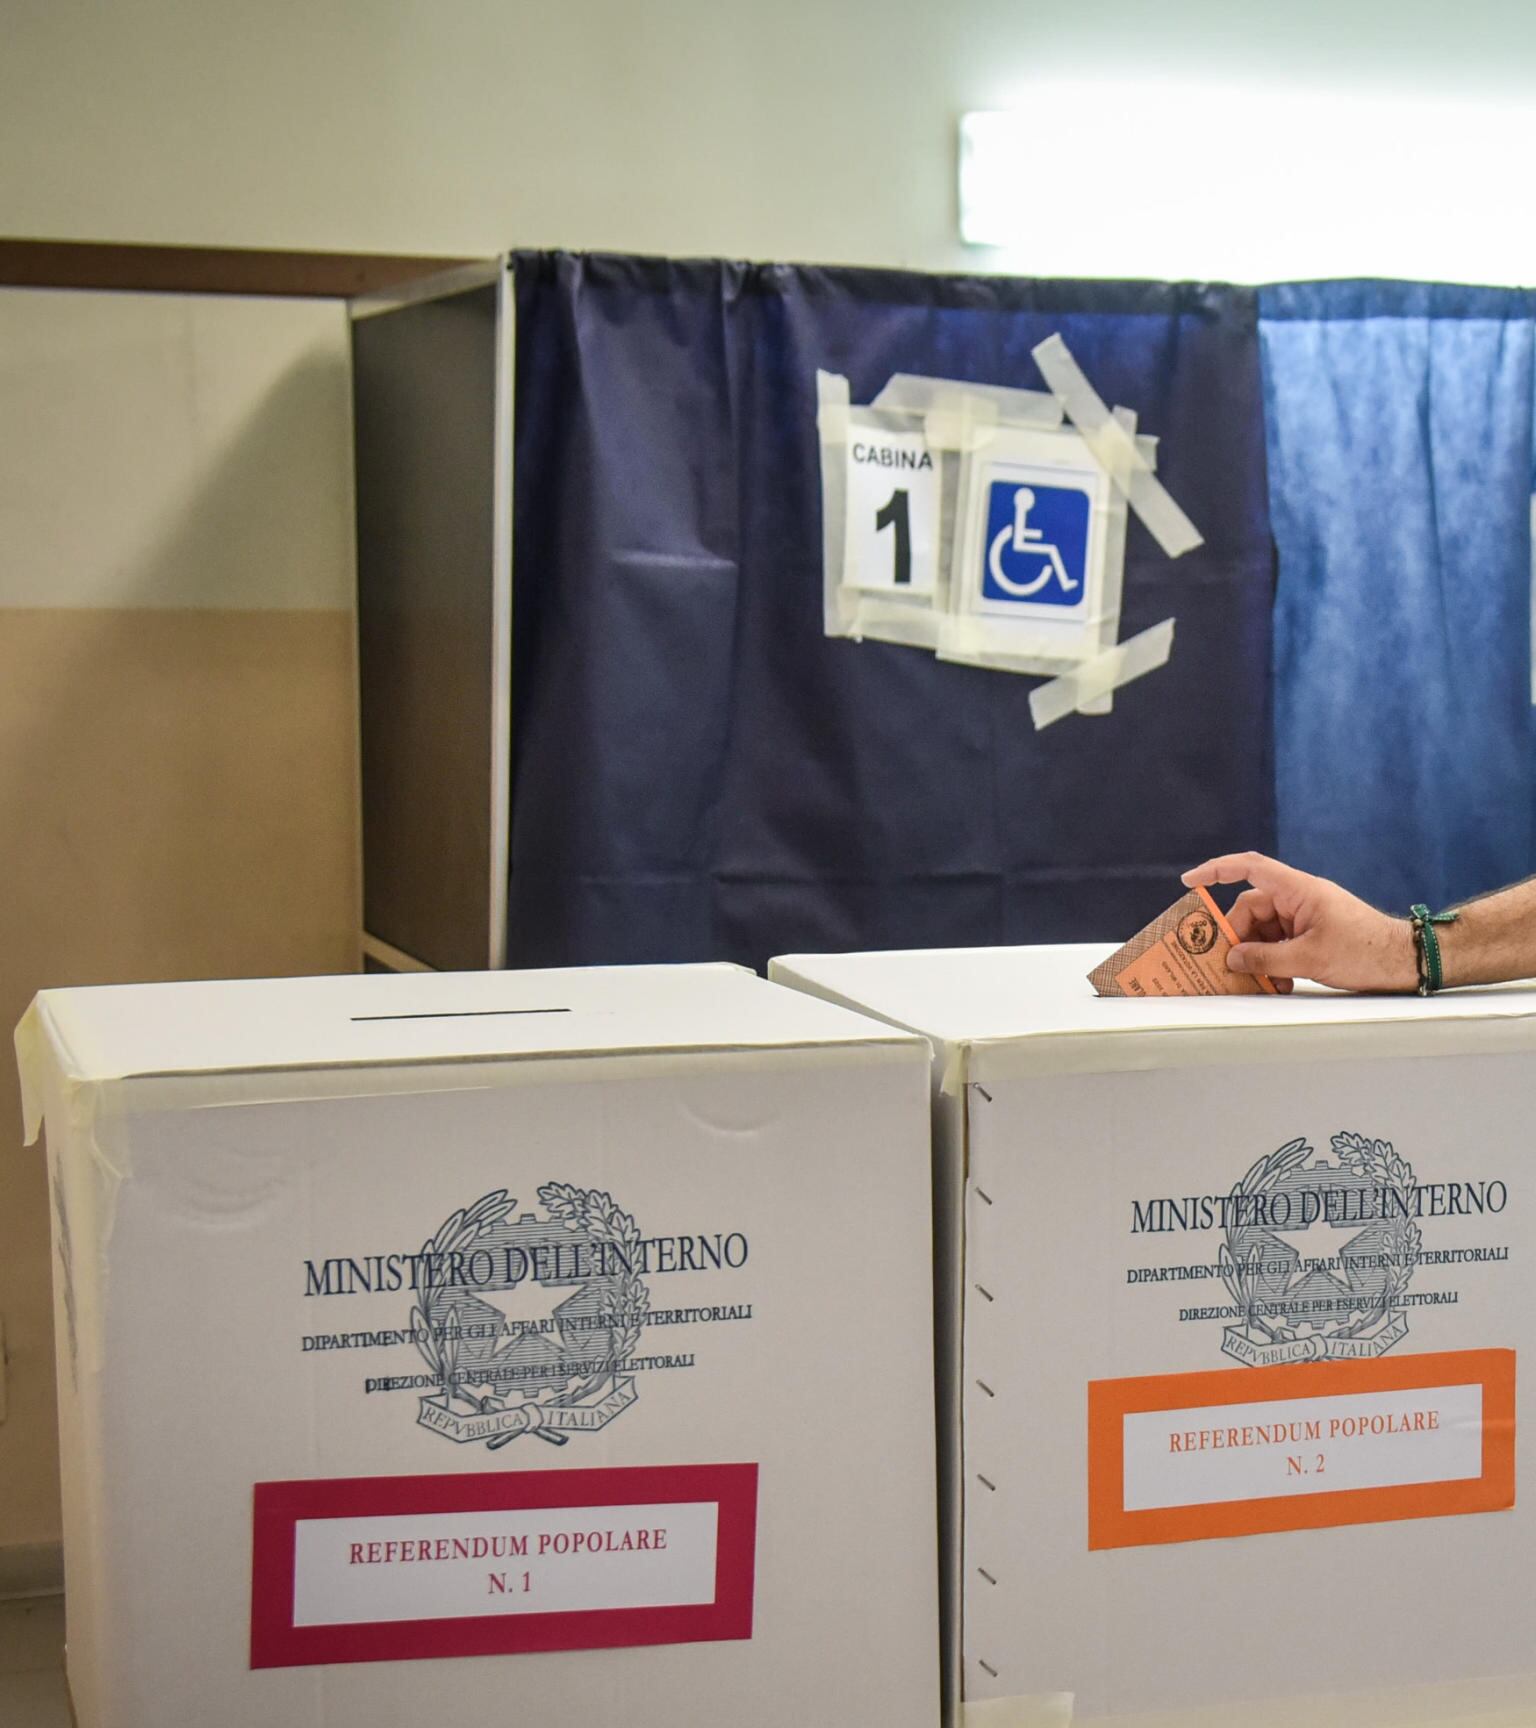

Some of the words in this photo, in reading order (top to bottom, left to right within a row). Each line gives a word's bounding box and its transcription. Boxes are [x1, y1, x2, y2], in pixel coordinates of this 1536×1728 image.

[853, 443, 933, 471] CABINA
[876, 489, 911, 585] 1
[1130, 1193, 1291, 1233] MINISTERO
[1300, 1180, 1508, 1223] DELL'INTERNO
[304, 1250, 494, 1296] MINISTERO
[505, 1232, 748, 1283] DELL'INTERNO
[1127, 1265, 1234, 1283] DIPARTIMENTO
[1238, 1262, 1263, 1276] PER
[1267, 1261, 1291, 1275] GLI
[1294, 1256, 1340, 1273] AFFARI
[1344, 1252, 1400, 1270] INTERNI
[1416, 1247, 1509, 1265] TERRITORIALI
[1179, 1304, 1247, 1321] DIREZIONE
[1249, 1301, 1309, 1316] CENTRALE
[1312, 1299, 1333, 1312] PER
[1388, 1292, 1458, 1307] ELETTORALI
[302, 1328, 429, 1351] DIPARTIMENTO
[434, 1325, 464, 1341] PER
[468, 1323, 498, 1339] GLI
[501, 1318, 555, 1337] AFFARI
[560, 1314, 627, 1333] INTERNI
[645, 1304, 752, 1326] TERRITORIALI
[1331, 1325, 1404, 1357] ITALIANA
[365, 1374, 446, 1393] DIREZIONE
[449, 1366, 520, 1386] CENTRALE
[523, 1364, 549, 1378] PER
[614, 1354, 695, 1372] ELETTORALI
[548, 1391, 632, 1426] ITALIANA
[1169, 1420, 1321, 1452] REFERENDUM
[1329, 1410, 1440, 1438] POPOLARE
[1287, 1455, 1308, 1475] N.
[1316, 1454, 1325, 1472] 2
[349, 1535, 530, 1564] REFERENDUM
[538, 1528, 668, 1556] POPOLARE
[488, 1573, 513, 1594] N.
[522, 1571, 531, 1592] 1
